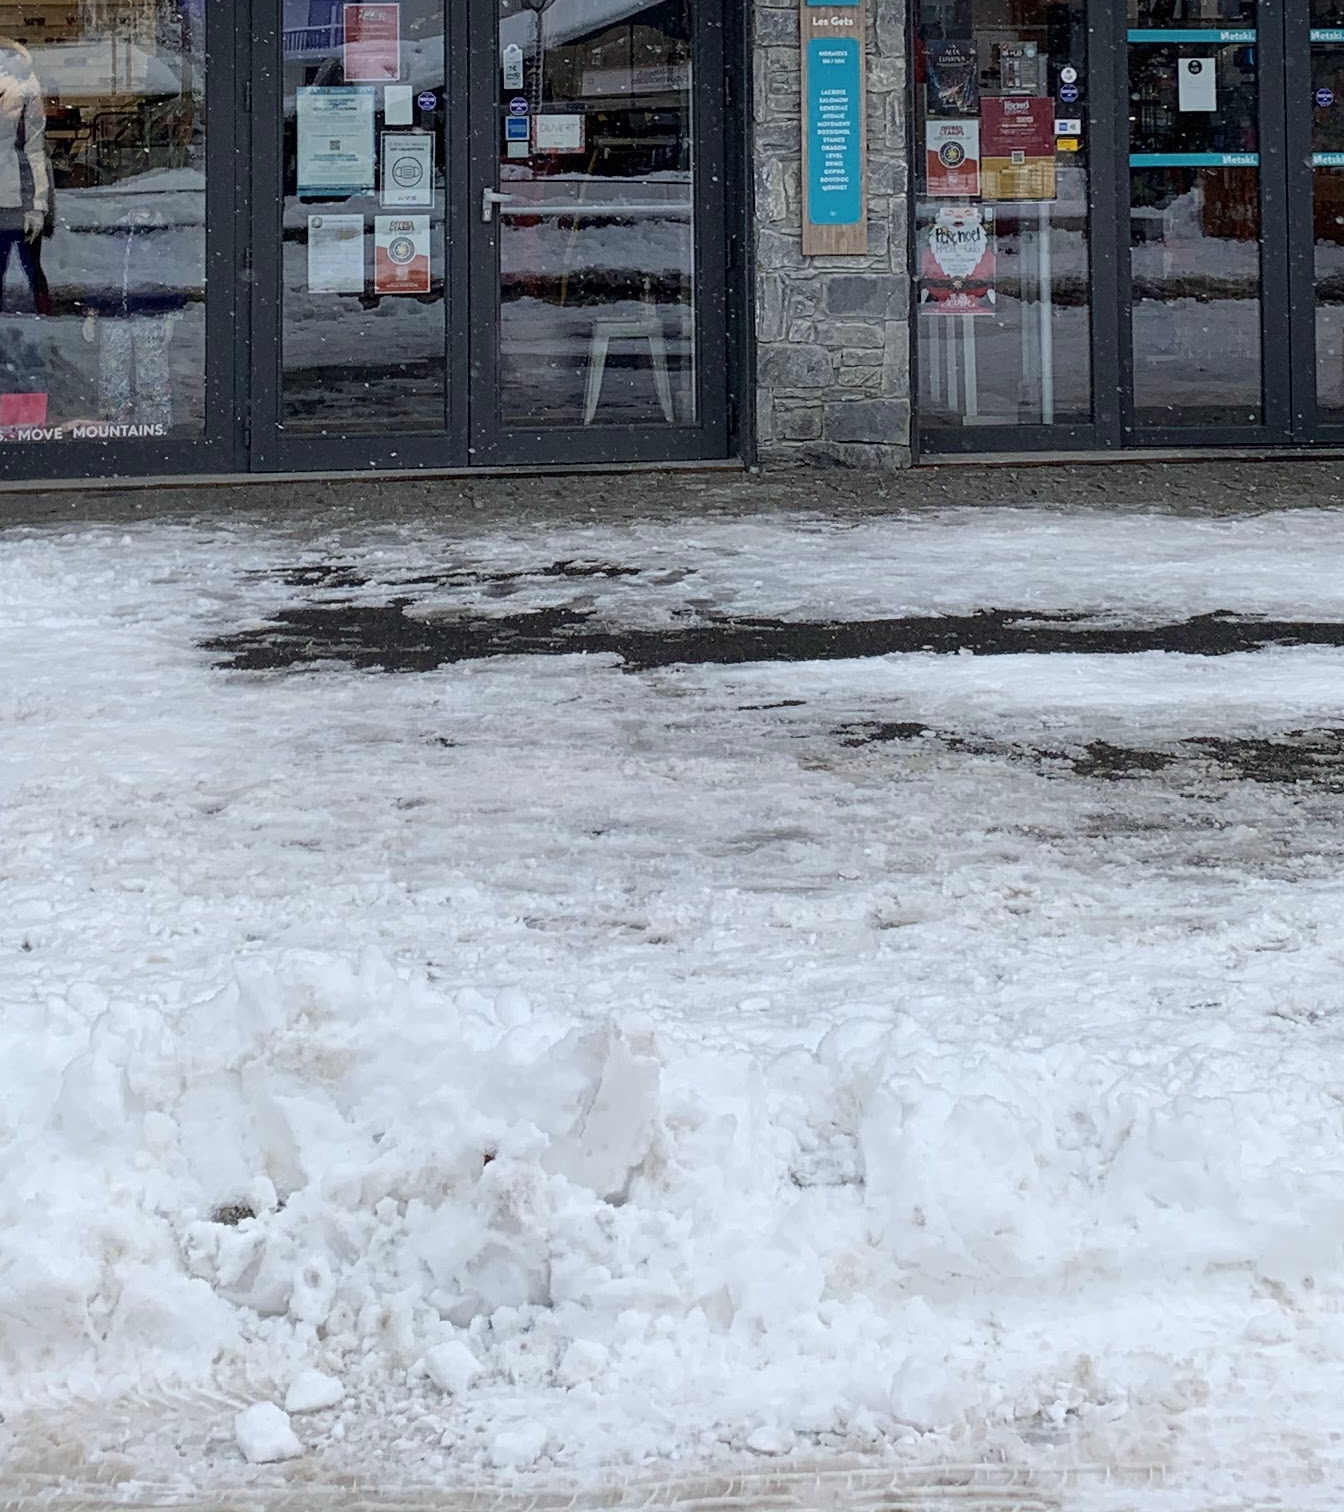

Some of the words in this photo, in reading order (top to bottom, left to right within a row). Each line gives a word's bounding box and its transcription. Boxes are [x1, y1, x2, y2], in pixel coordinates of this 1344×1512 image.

[812, 16, 829, 26] Les
[830, 16, 854, 26] Gets
[18, 428, 63, 441] MOVE
[73, 425, 167, 439] MOUNTAINS.
